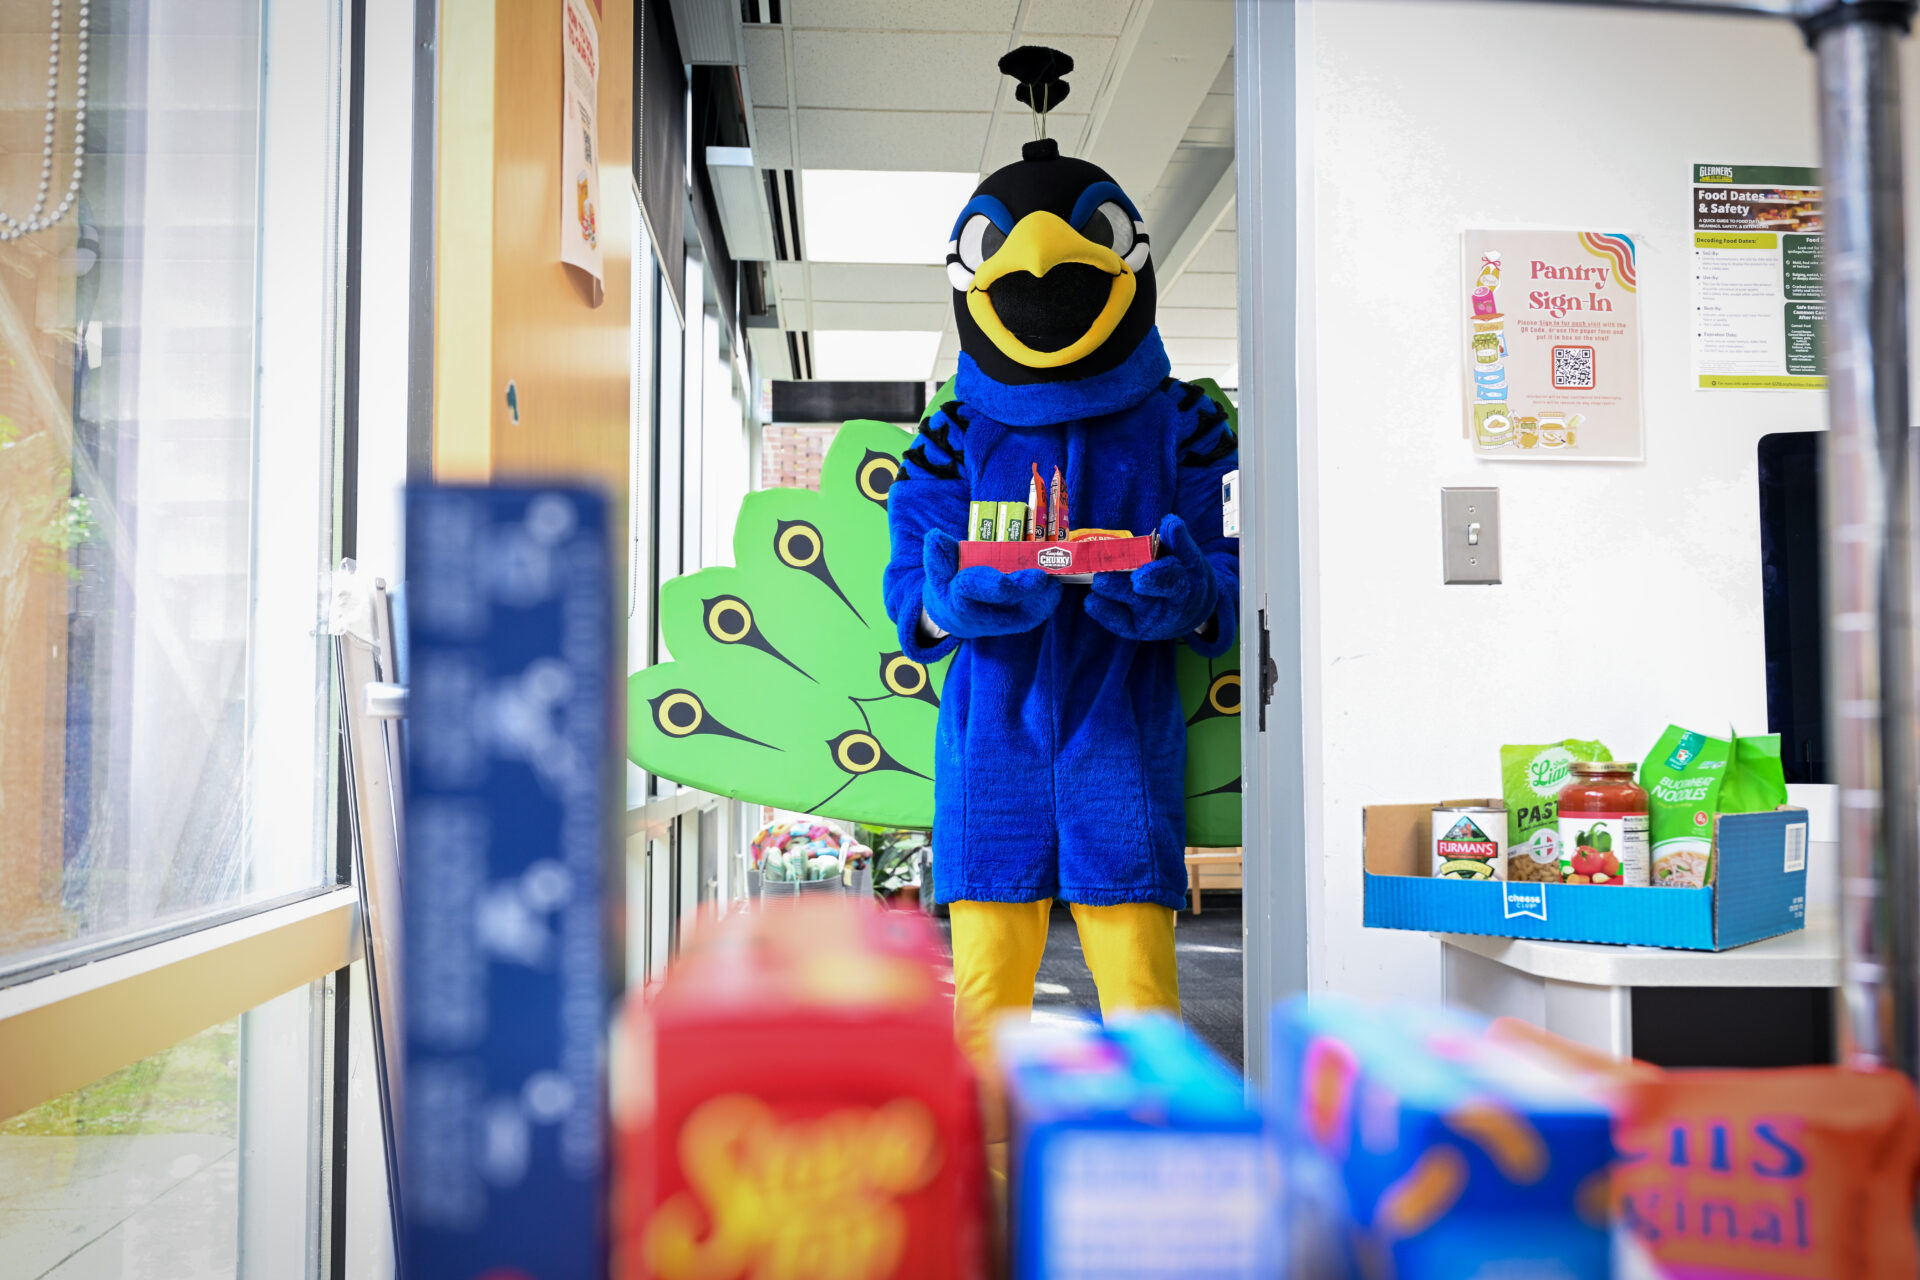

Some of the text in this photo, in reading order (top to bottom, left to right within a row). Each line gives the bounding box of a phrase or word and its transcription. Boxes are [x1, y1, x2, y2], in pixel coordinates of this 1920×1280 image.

[1700, 166, 1732, 178] GLEANERS
[1698, 190, 1765, 200] Food Dates
[1698, 203, 1750, 216] & Safety
[1530, 260, 1610, 290] Pantry
[1529, 290, 1613, 319] Sign-In
[1040, 555, 1070, 566] CHUNKY
[1659, 776, 1716, 790] BUCKWHEAT
[1651, 785, 1709, 802] NOODLES
[1439, 842, 1494, 856] FURMAN'S
[1508, 894, 1541, 904] cheese
